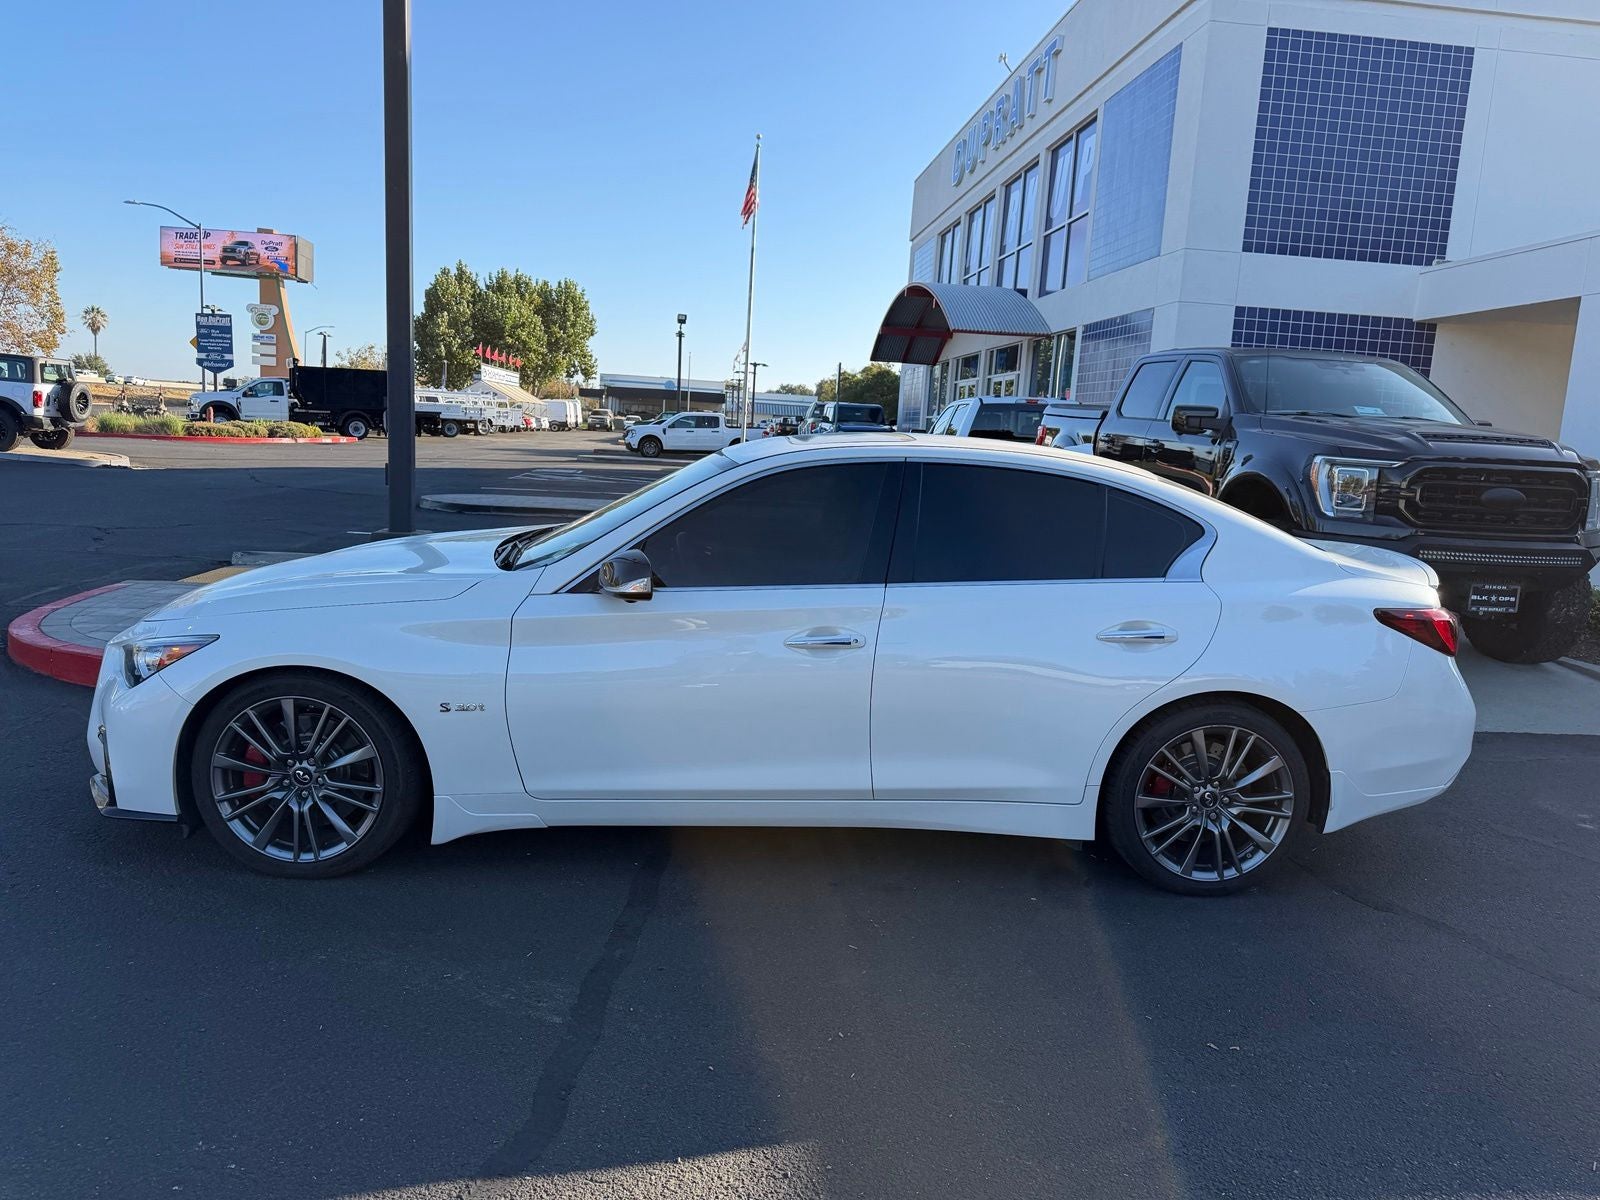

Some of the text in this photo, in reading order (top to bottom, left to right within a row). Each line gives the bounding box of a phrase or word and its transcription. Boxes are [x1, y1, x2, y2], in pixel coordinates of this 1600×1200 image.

[952, 34, 1064, 187] DUPRATT
[174, 232, 199, 240] TRADE
[439, 702, 451, 713] S
